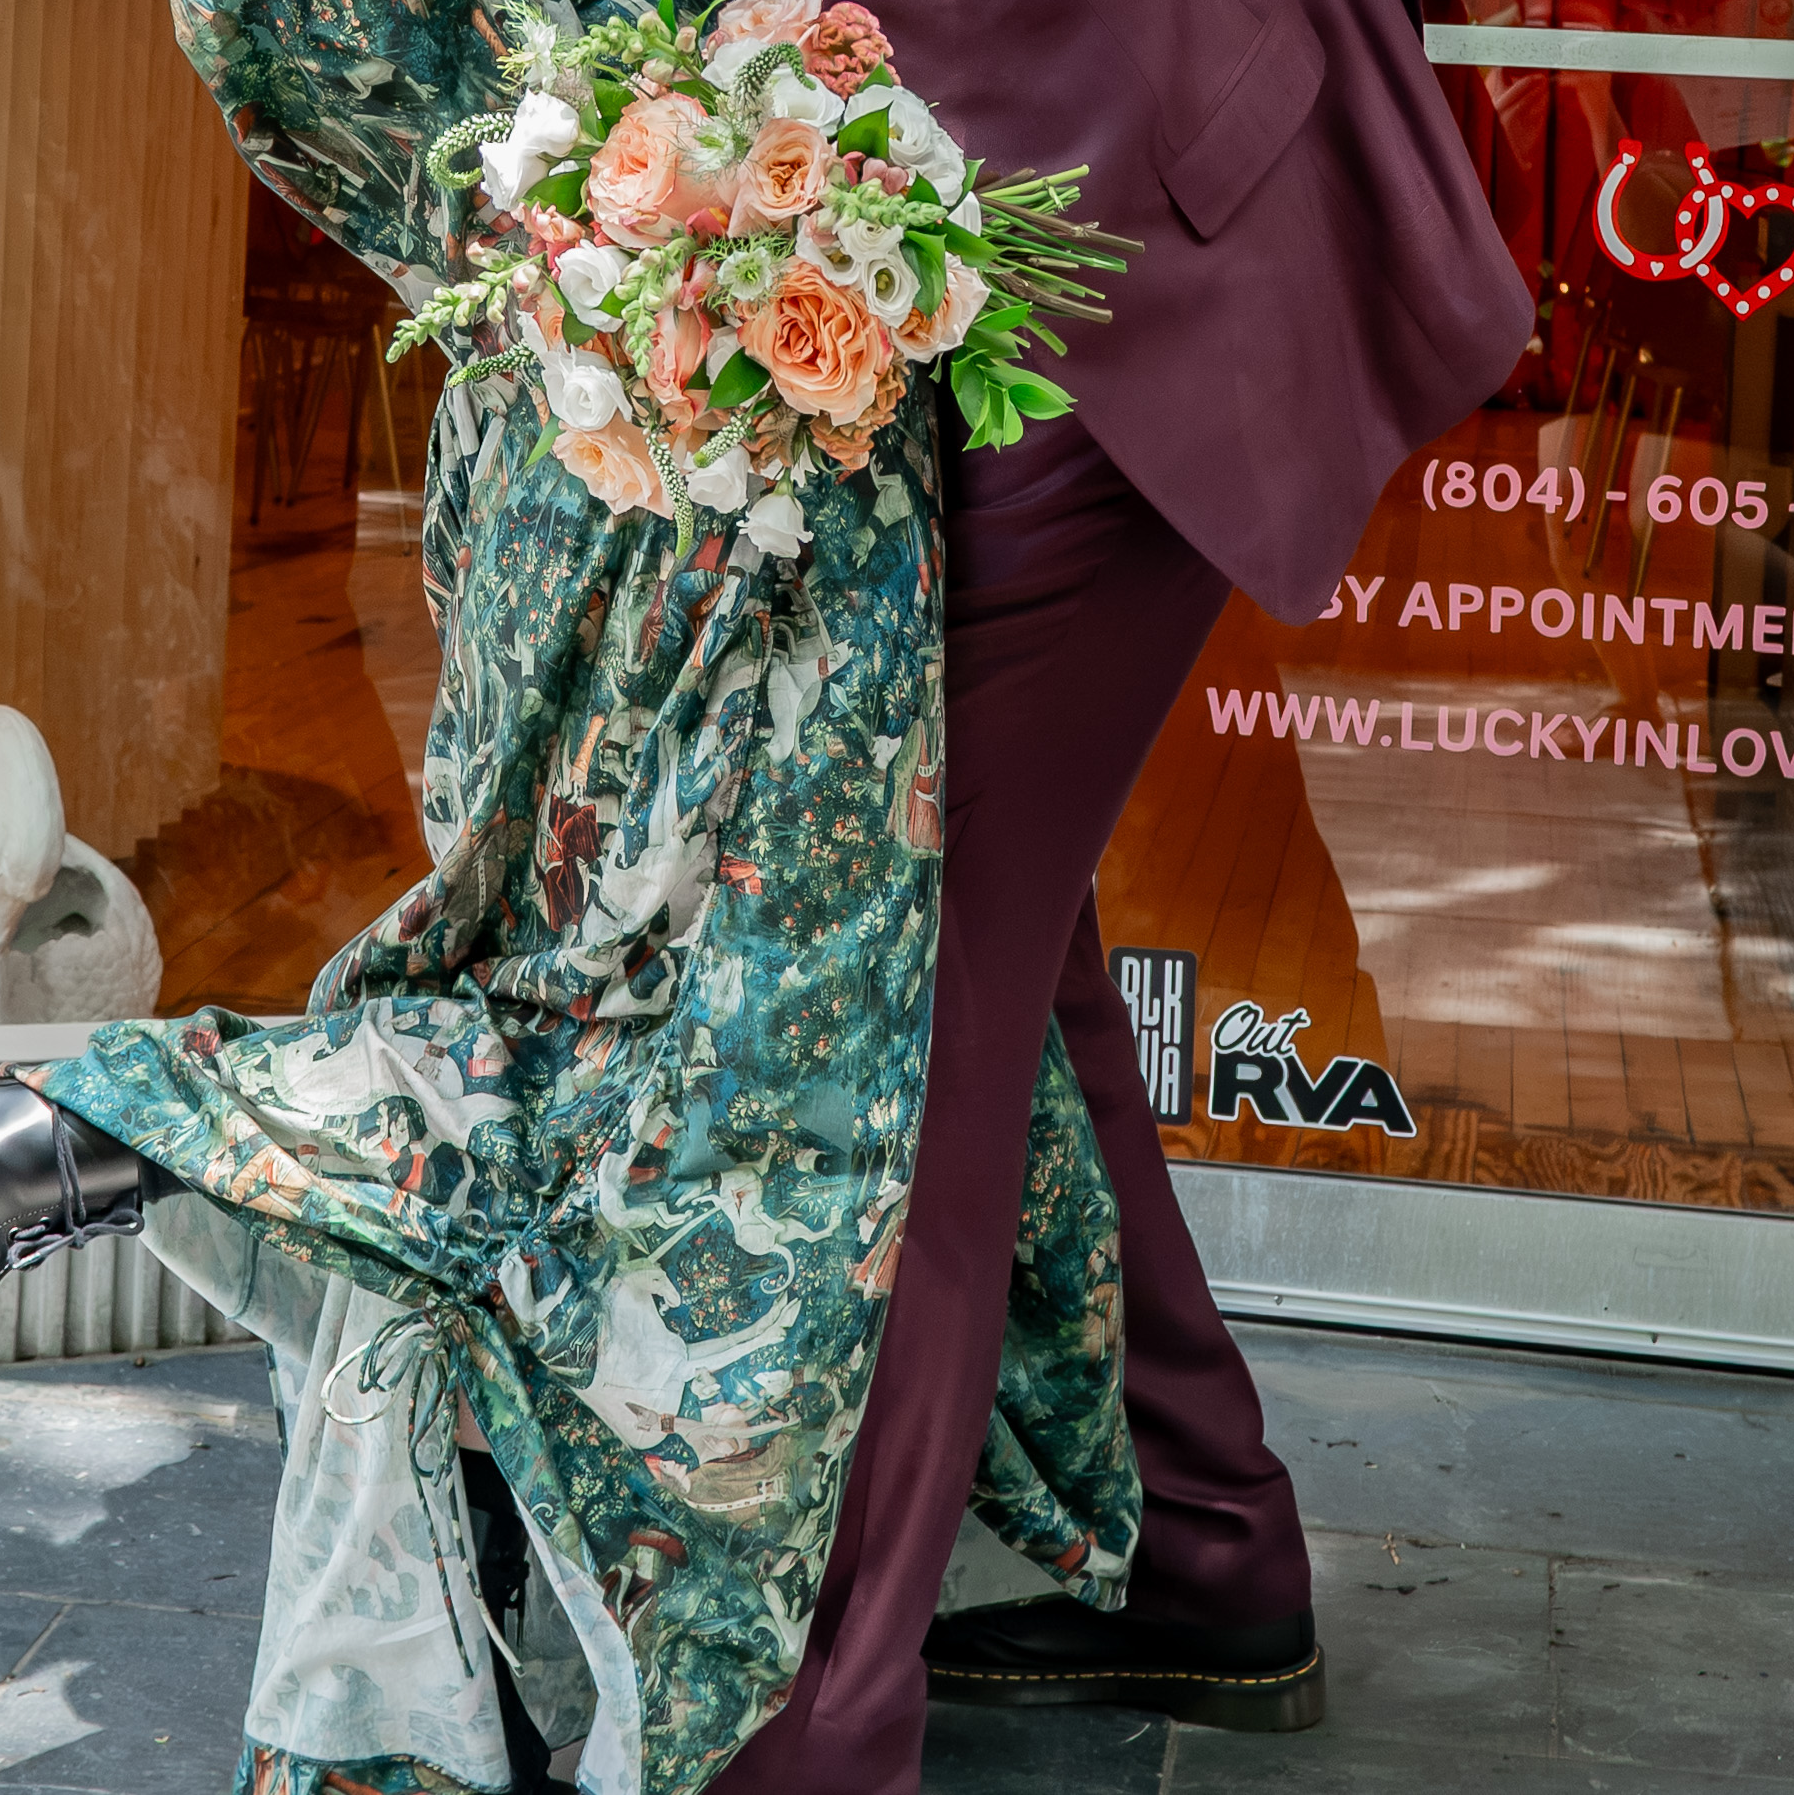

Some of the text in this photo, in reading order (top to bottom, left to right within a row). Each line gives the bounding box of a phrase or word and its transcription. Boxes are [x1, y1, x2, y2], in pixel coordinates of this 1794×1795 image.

[1422, 458, 1586, 523] (804)
[1646, 474, 1769, 530] 605
[1211, 1001, 1310, 1056] Out
[1208, 1054, 1417, 1138] RVA
